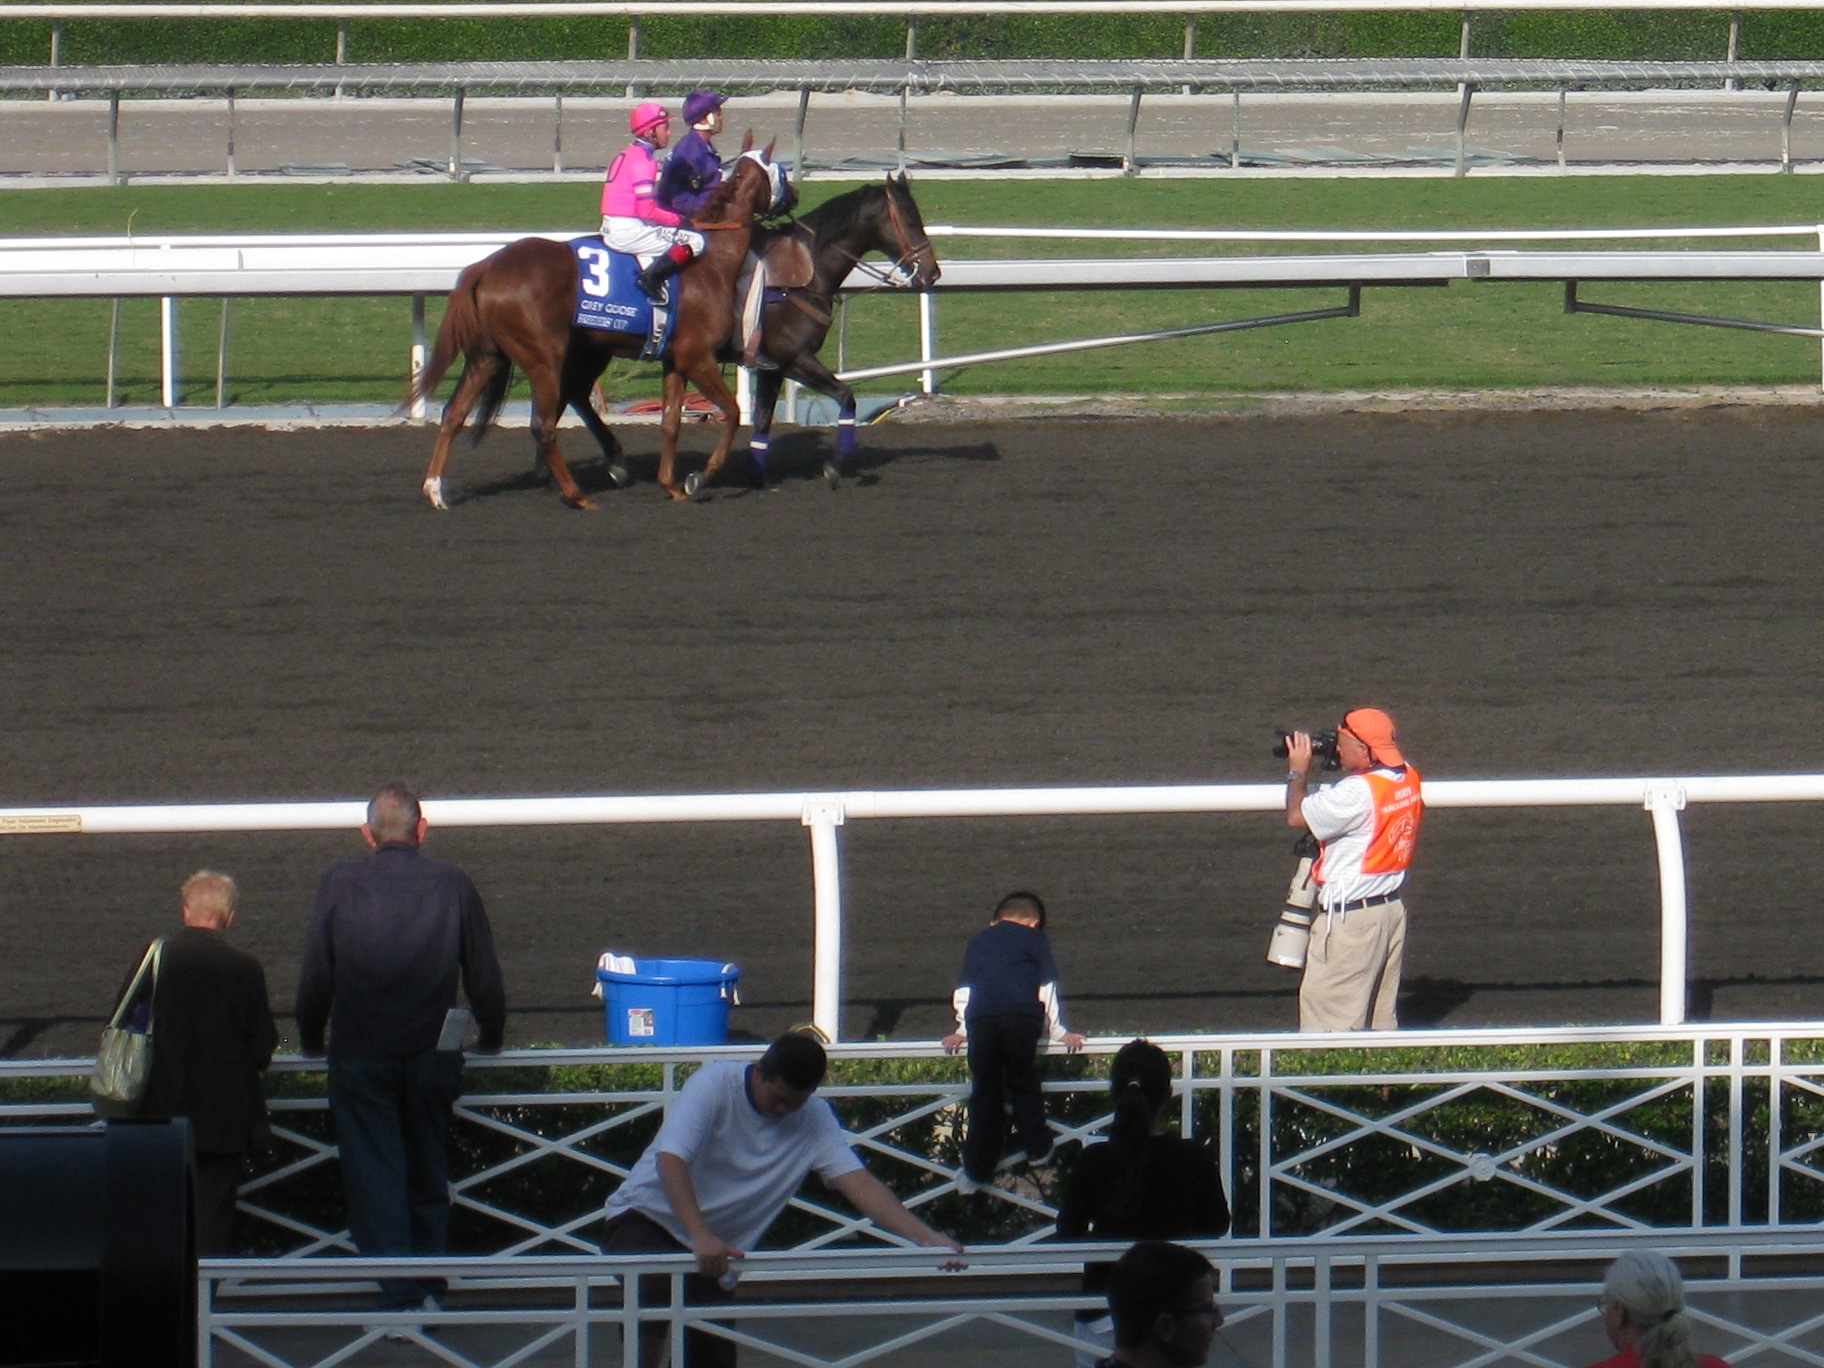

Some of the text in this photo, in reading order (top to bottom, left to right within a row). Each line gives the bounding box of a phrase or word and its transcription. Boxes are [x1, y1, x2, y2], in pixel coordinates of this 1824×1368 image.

[577, 245, 610, 297] 3
[580, 299, 639, 317] GREY GOOSE
